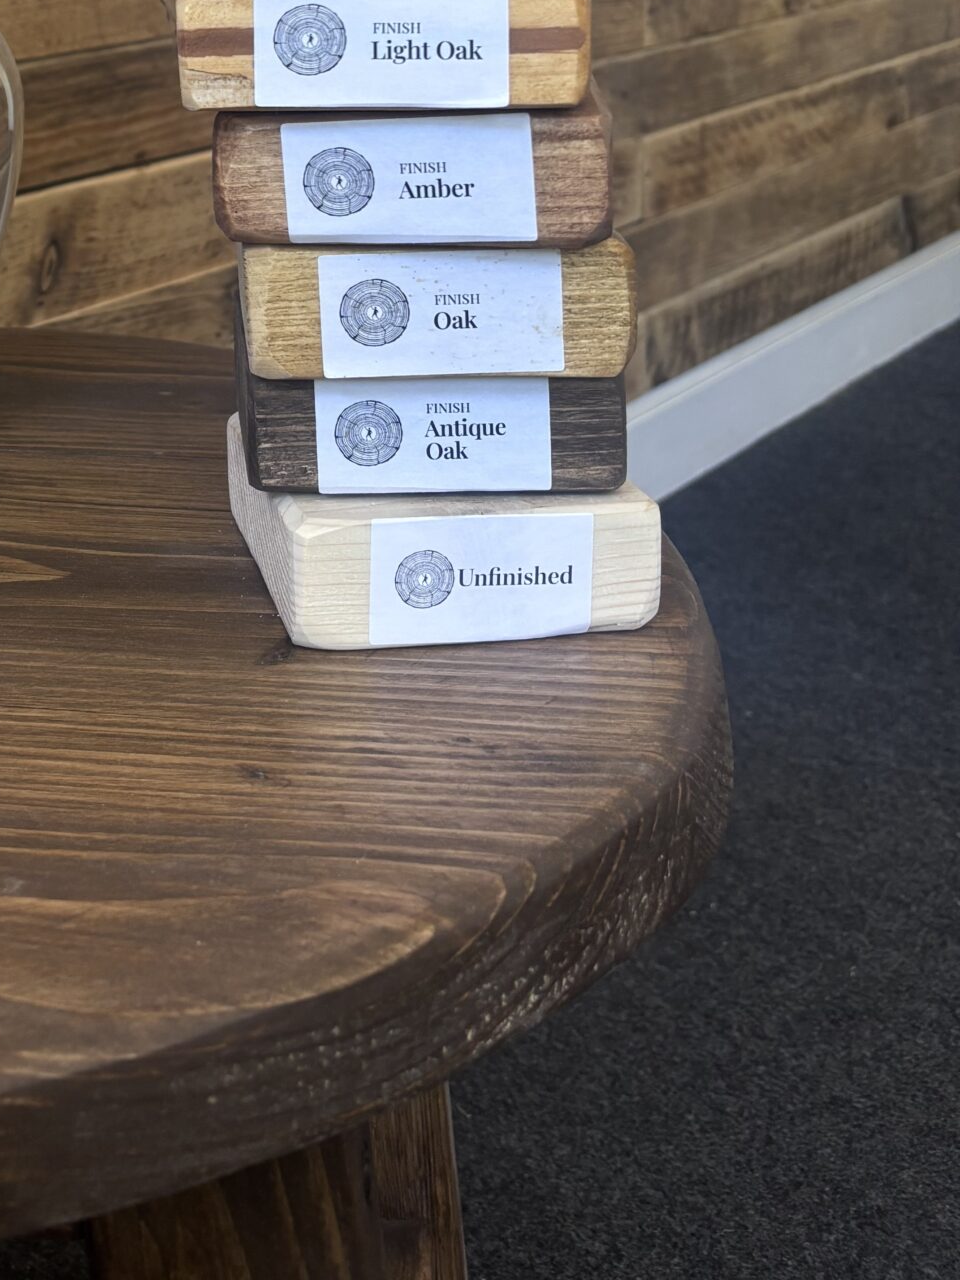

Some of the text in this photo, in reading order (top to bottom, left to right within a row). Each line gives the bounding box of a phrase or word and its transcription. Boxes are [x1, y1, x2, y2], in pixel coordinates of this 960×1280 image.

[372, 21, 422, 35] FINISH
[371, 38, 483, 65] Light Oak
[398, 161, 448, 174] FINISH
[398, 178, 475, 199] Amber
[433, 293, 481, 306] FINISH
[433, 310, 478, 331] Oak
[425, 402, 471, 414] FINISH
[424, 418, 507, 442] Antique
[426, 441, 469, 461] Oak
[457, 565, 574, 588] Unfinished
